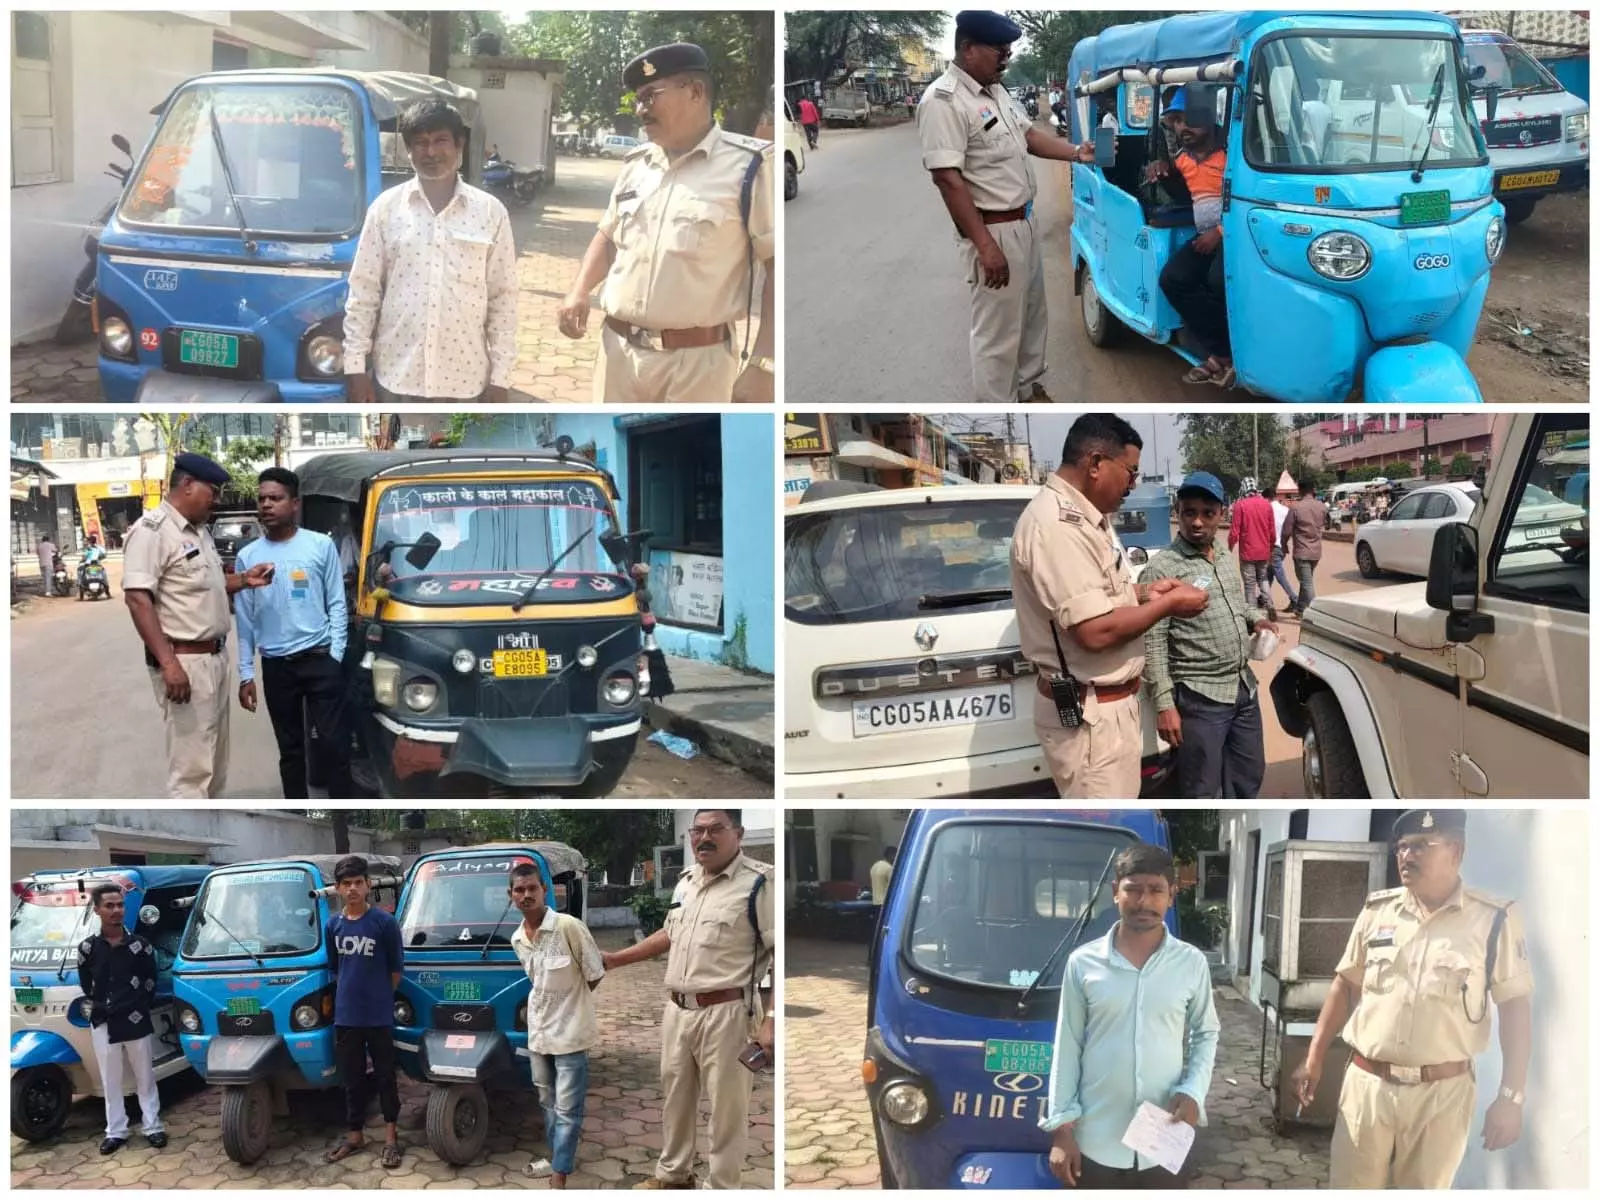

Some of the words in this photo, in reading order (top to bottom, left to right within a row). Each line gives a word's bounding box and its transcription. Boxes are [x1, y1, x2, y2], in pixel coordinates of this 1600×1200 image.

[1416, 254, 1449, 270] GOGO
[141, 333, 158, 345] 92
[477, 489, 506, 502] काल
[512, 488, 564, 503] महाकाल
[504, 652, 541, 663] CG05A
[504, 663, 541, 675] E8095
[822, 661, 1034, 694] DUSTER
[870, 694, 1012, 727] CG05AA4676
[335, 936, 376, 957] LOVE
[12, 948, 48, 963] NITYA
